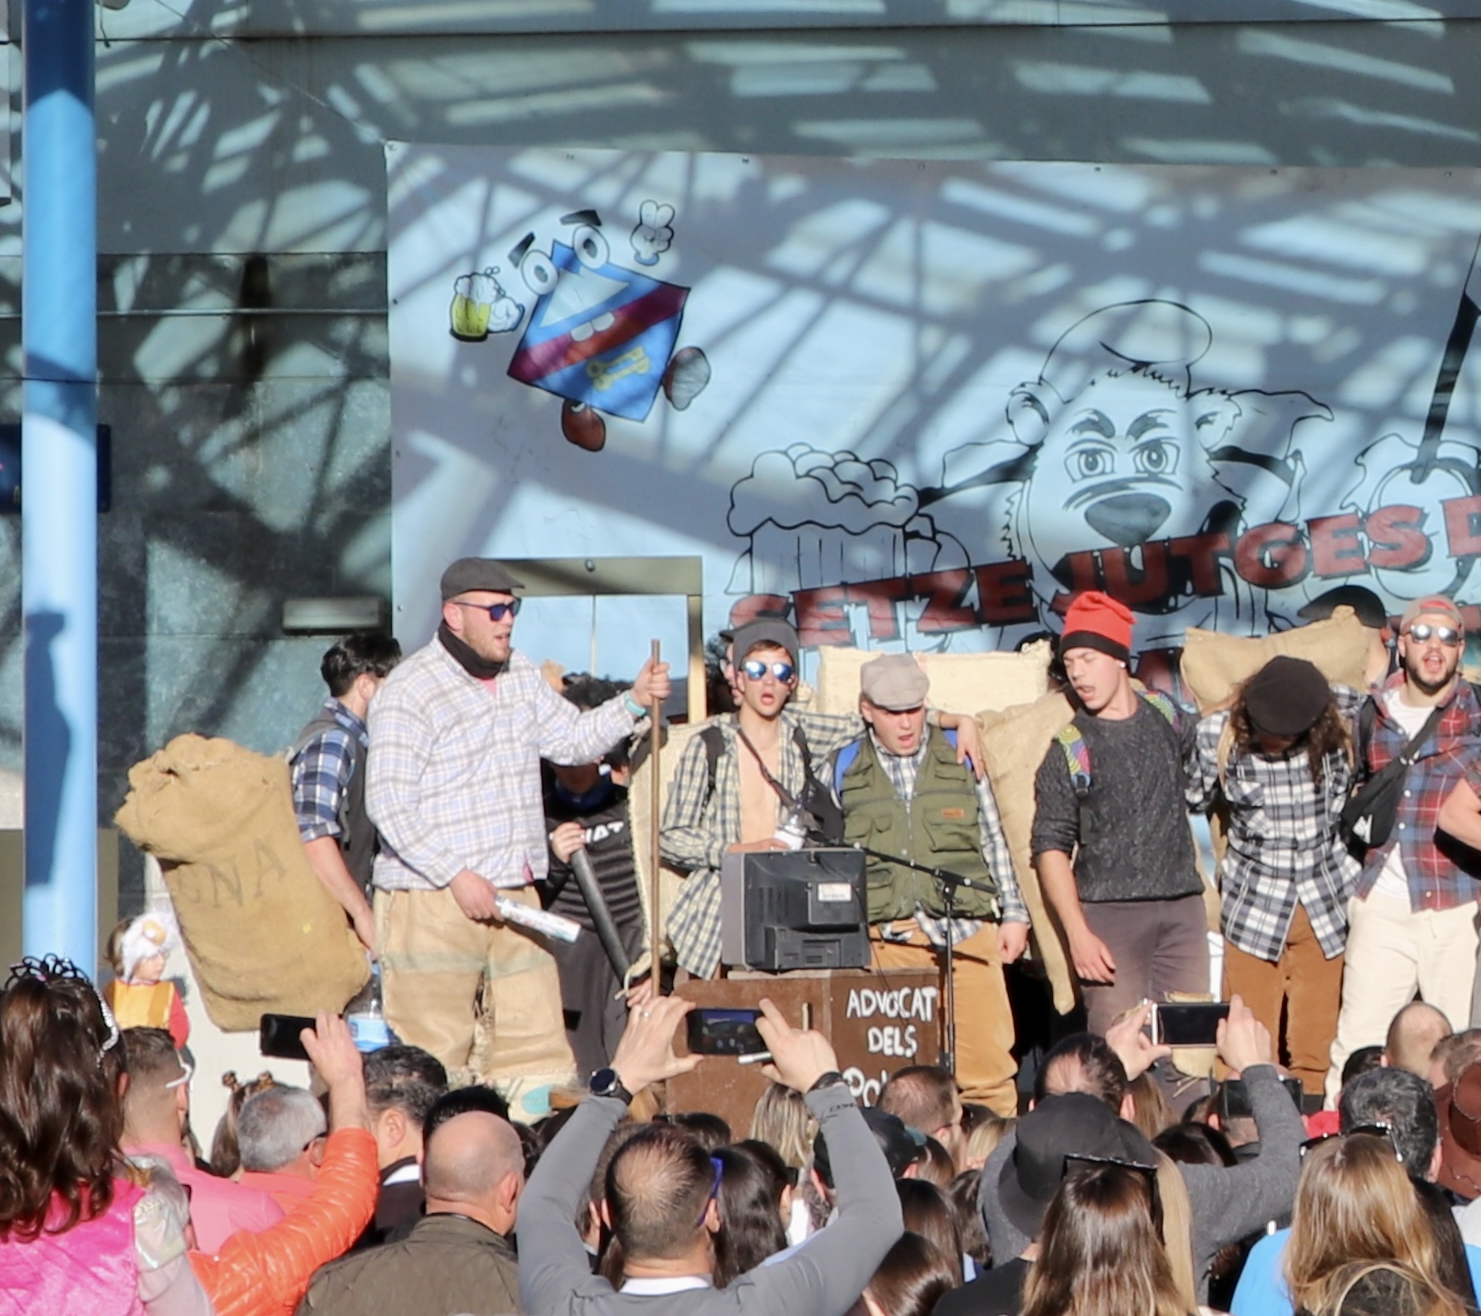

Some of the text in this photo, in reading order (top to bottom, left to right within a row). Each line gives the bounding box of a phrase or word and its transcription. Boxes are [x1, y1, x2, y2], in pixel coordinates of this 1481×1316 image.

[1049, 504, 1434, 616] JUTGES
[846, 986, 938, 1022] ADVOCAT
[867, 1025, 918, 1058] DELS
